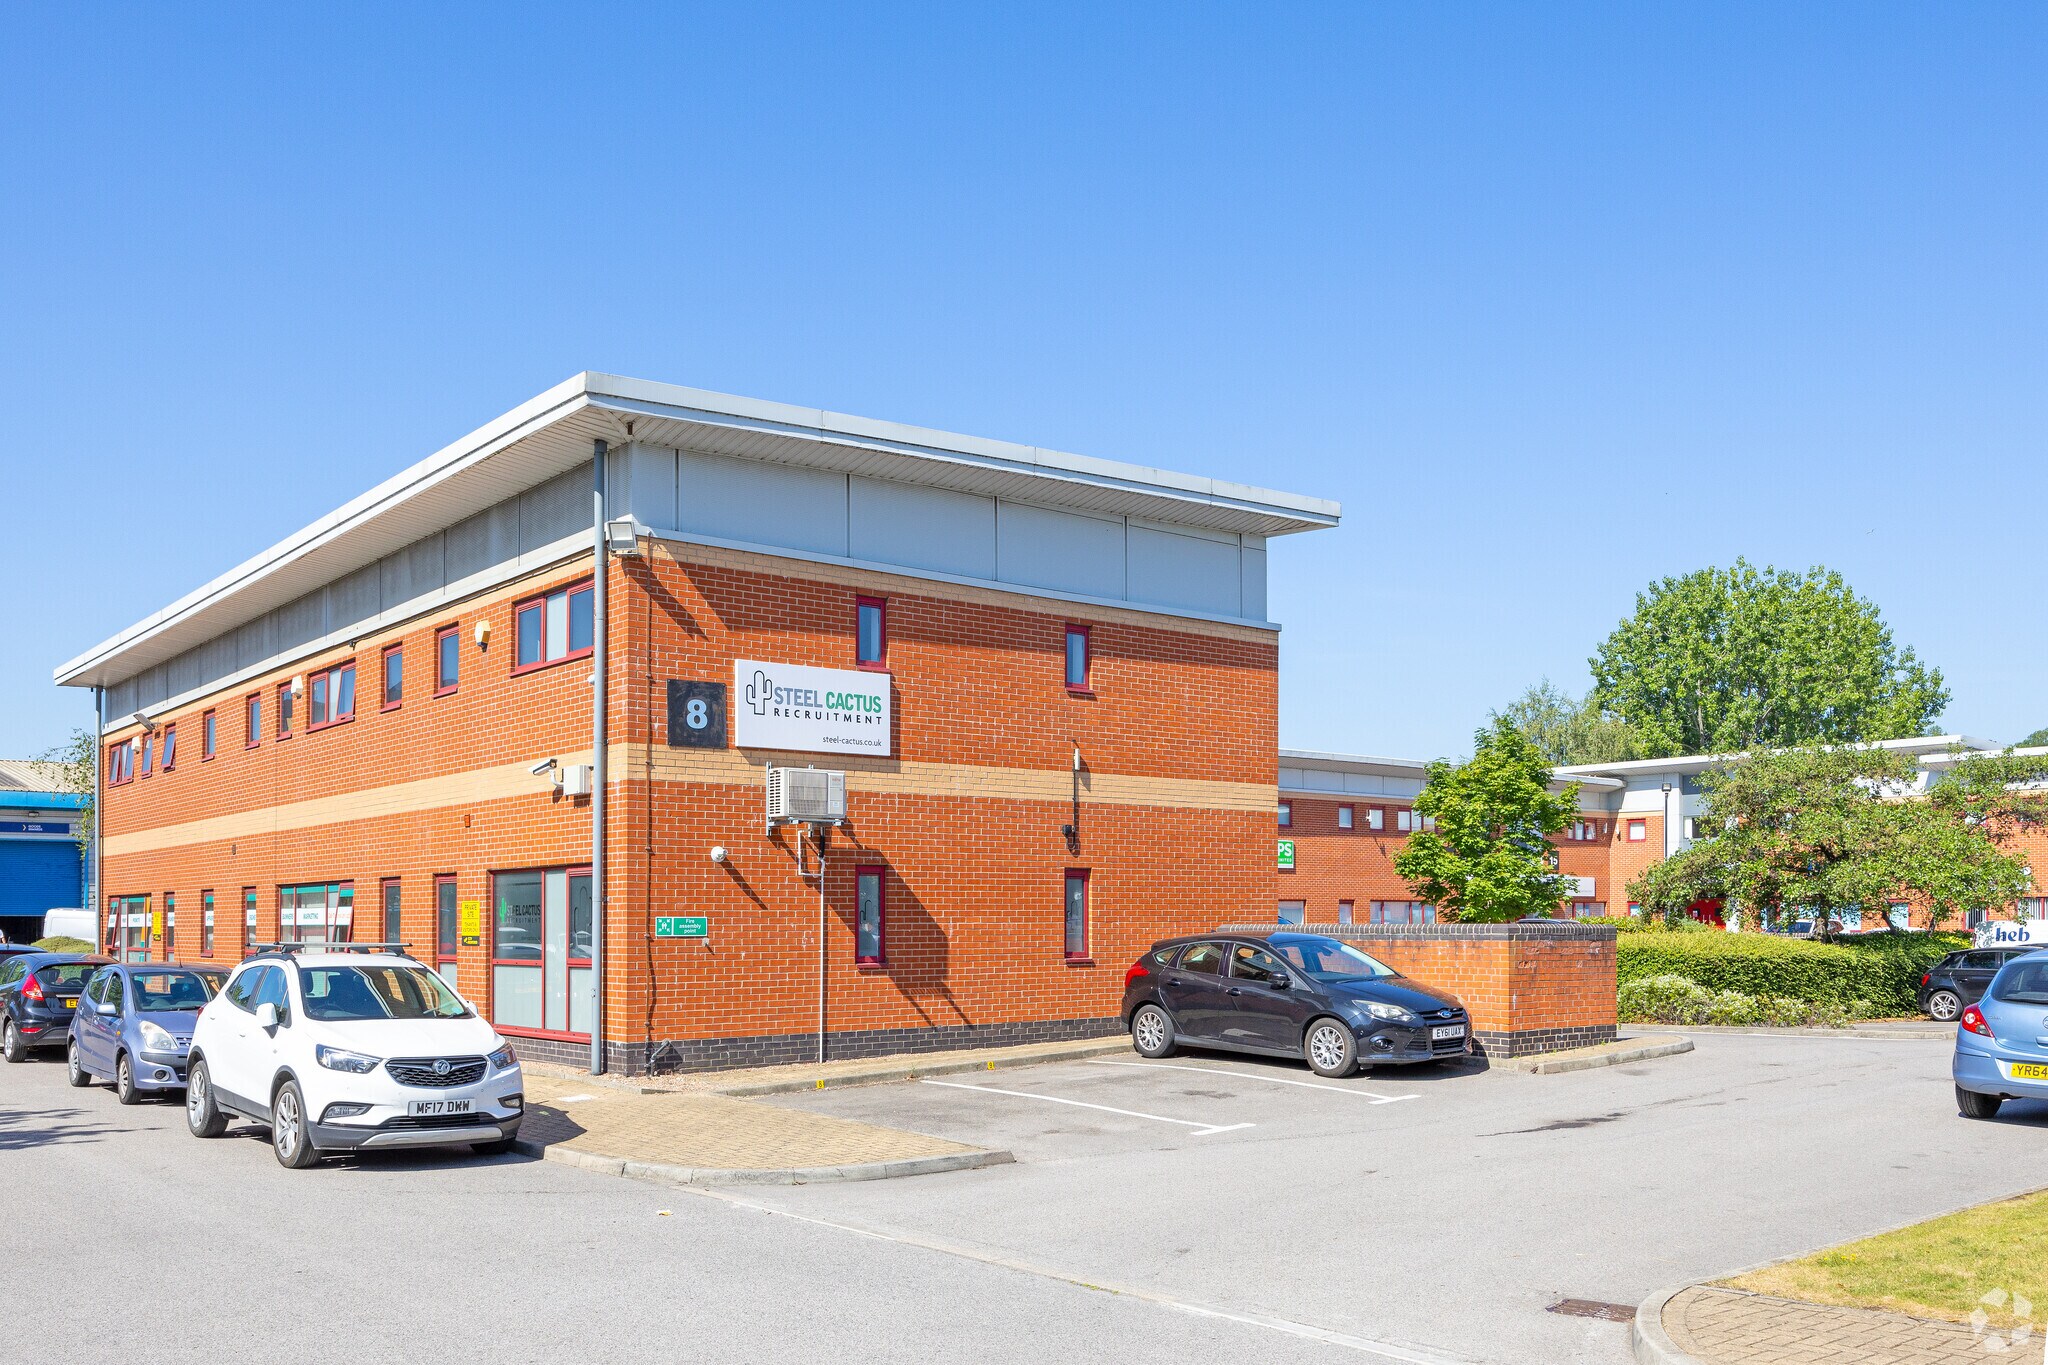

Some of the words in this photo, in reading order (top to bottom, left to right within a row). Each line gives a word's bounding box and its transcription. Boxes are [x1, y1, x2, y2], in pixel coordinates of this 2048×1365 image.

[774, 686, 823, 708] STEEL
[825, 691, 882, 714] CACTUS
[686, 699, 708, 730] 8
[774, 707, 882, 725] RECRUITMENT
[822, 735, 882, 747] steel-cactus.co.uk
[1996, 927, 2031, 942] heb
[1436, 1028, 1450, 1037] EY61
[1451, 1026, 1461, 1036] UAX
[2017, 1065, 2048, 1077] YR64
[416, 1101, 444, 1114] MF17
[447, 1100, 470, 1113] DWW
